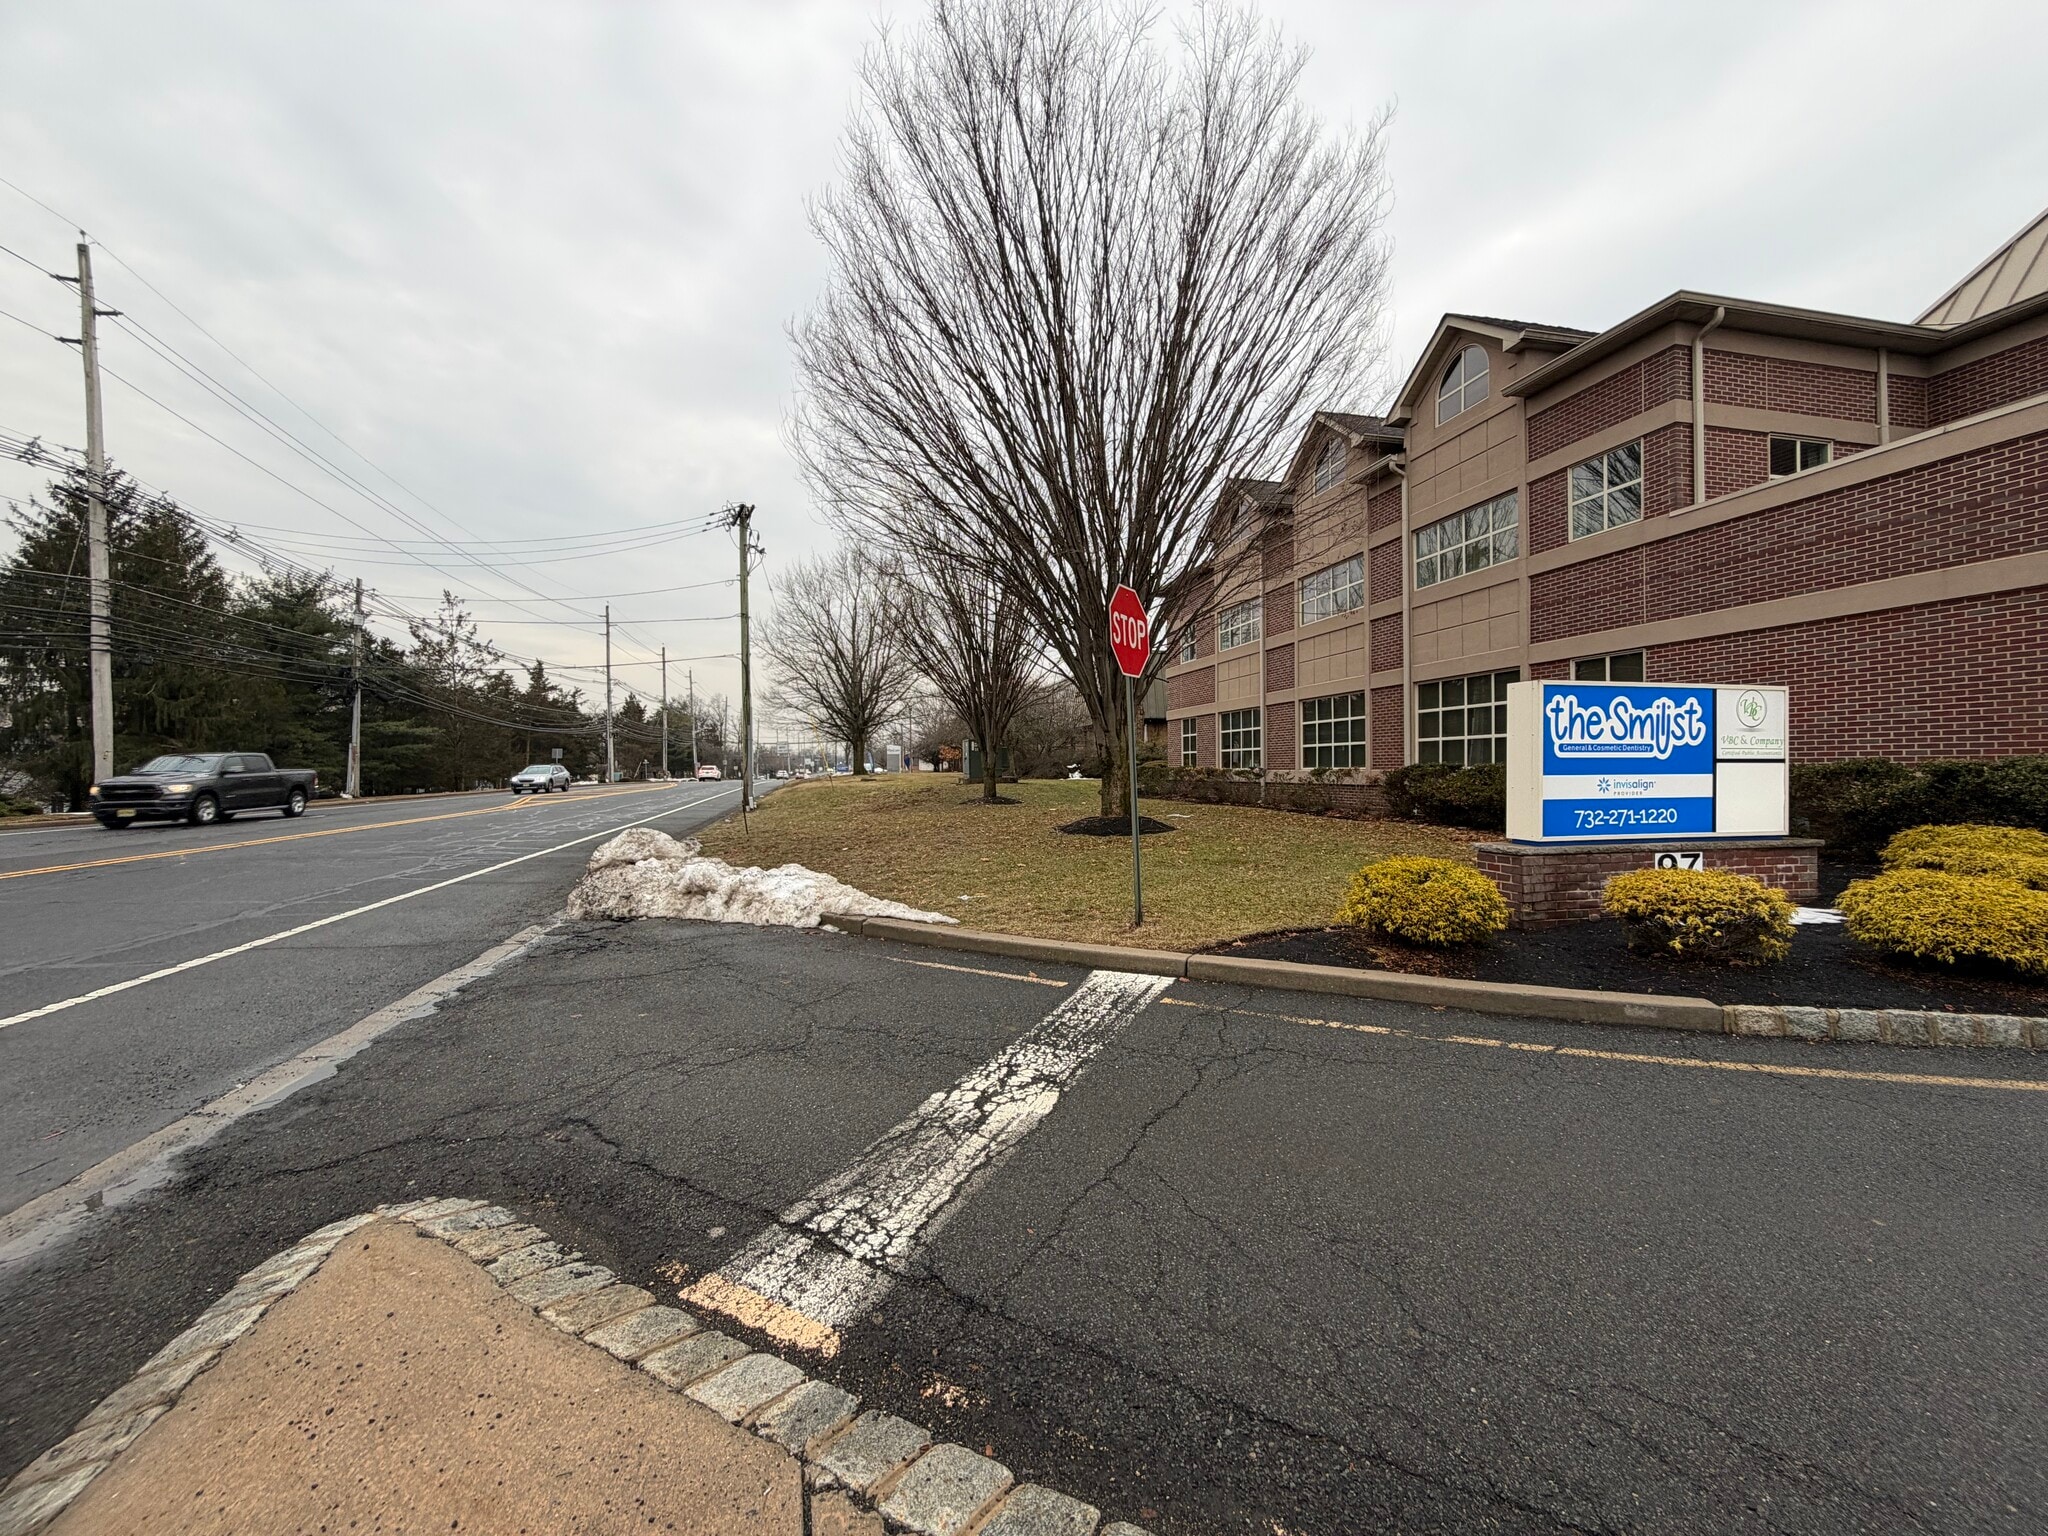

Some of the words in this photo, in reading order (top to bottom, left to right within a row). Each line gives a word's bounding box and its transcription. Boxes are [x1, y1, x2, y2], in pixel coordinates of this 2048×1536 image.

[1113, 611, 1146, 650] STOP
[1549, 698, 1605, 740] the
[1562, 744, 1587, 752] General
[1588, 744, 1593, 752] &
[1593, 744, 1622, 752] Cosmetic
[1623, 744, 1651, 753] Dentistry
[1721, 735, 1739, 745] VBC
[1741, 735, 1748, 745] &
[1750, 736, 1784, 748] Company
[1613, 779, 1655, 791] invisalign
[1574, 808, 1678, 829] 732-271-1220
